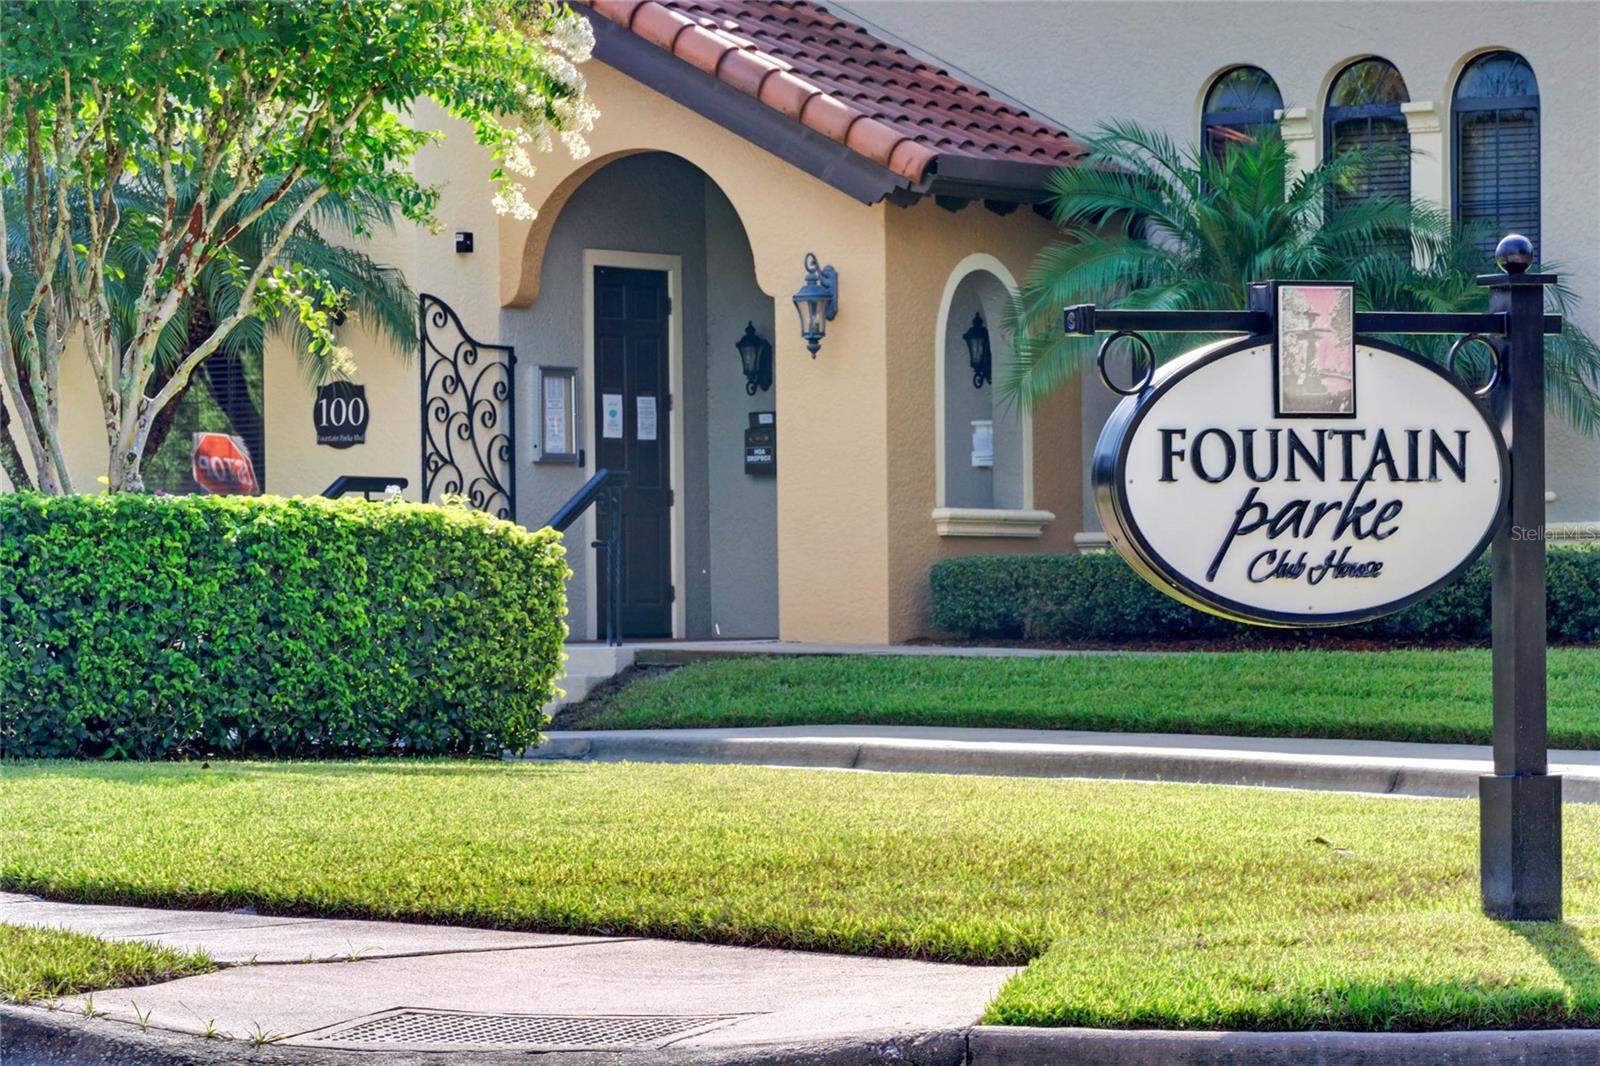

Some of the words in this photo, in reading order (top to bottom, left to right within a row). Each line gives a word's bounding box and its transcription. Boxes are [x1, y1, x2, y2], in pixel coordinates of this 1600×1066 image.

[319, 397, 365, 427] 100
[753, 448, 766, 456] HOA
[1157, 428, 1471, 483] FOUNTAIN
[1205, 479, 1403, 582] parke
[1247, 548, 1308, 583] Club
[1306, 545, 1384, 586] House
